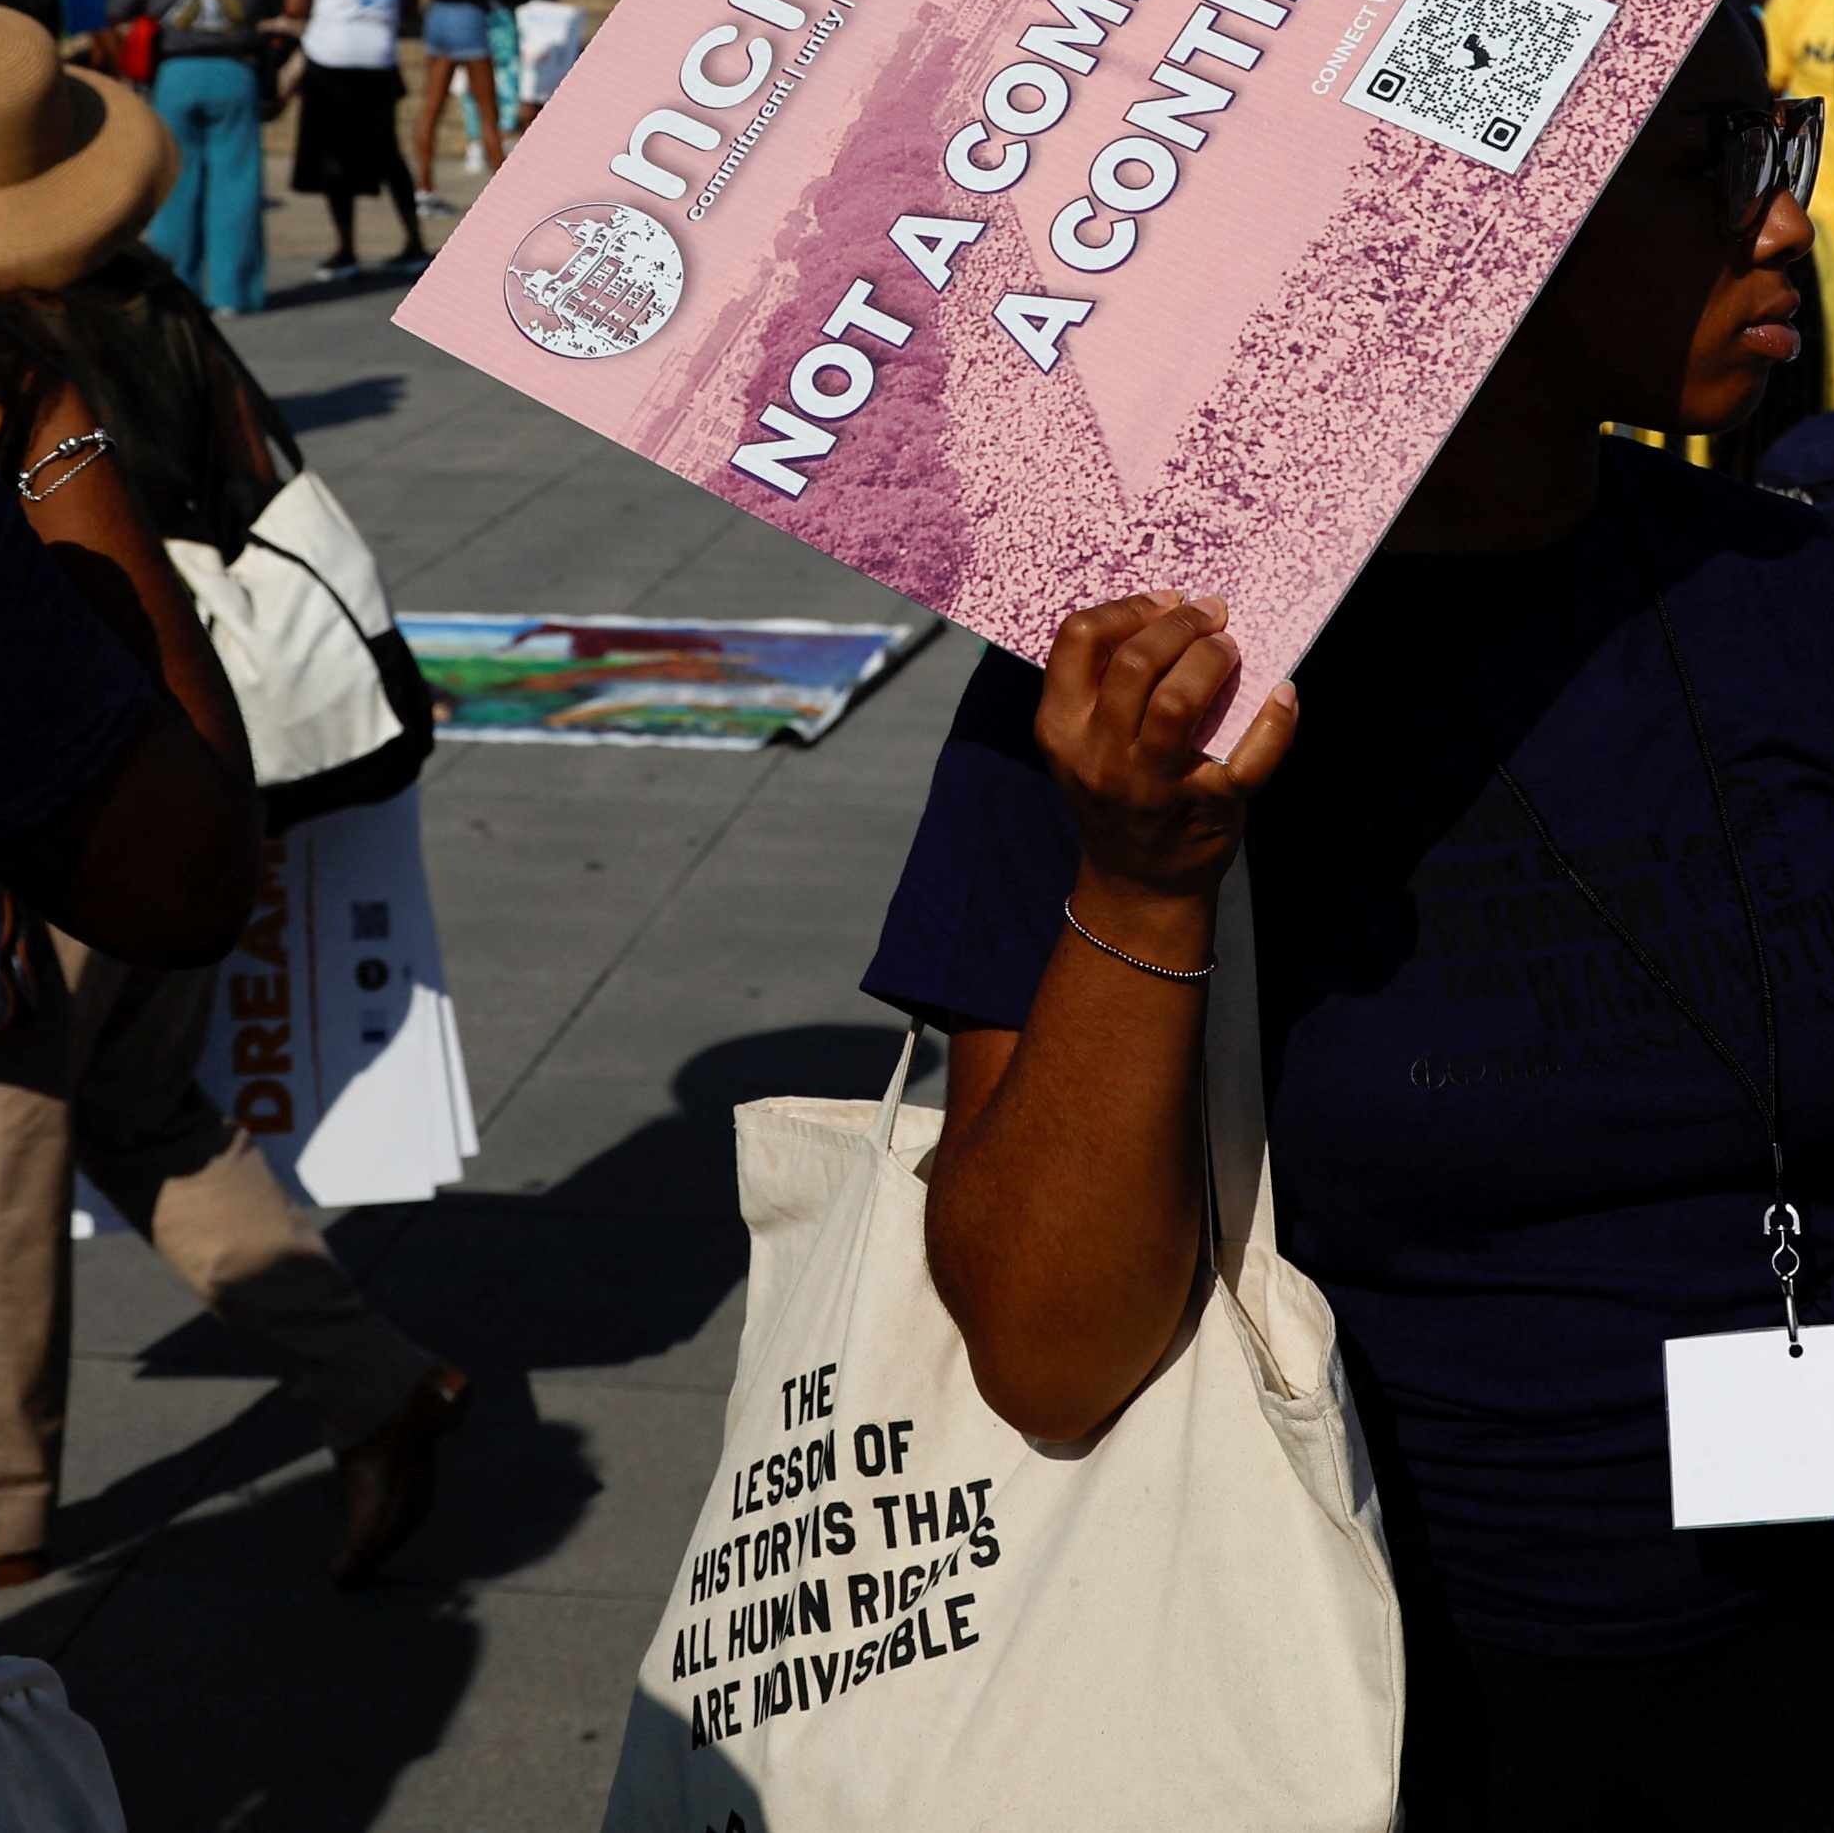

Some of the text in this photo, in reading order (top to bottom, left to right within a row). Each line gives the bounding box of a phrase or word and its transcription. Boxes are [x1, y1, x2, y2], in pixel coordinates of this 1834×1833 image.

[1311, 8, 1371, 96] CONNECT
[687, 78, 795, 221] commitment
[796, 6, 846, 68] unity
[730, 278, 915, 500] NOT
[889, 212, 986, 292] A
[992, 292, 1095, 374] A
[782, 1362, 837, 1431] THE
[732, 1420, 914, 1521] LESSON OF
[689, 1477, 994, 1606] HISTORY IS THAT
[672, 1623, 718, 1683] ALL
[728, 1578, 832, 1662] HUMAN
[690, 1593, 981, 1751] ARE INDIVISIBLE
